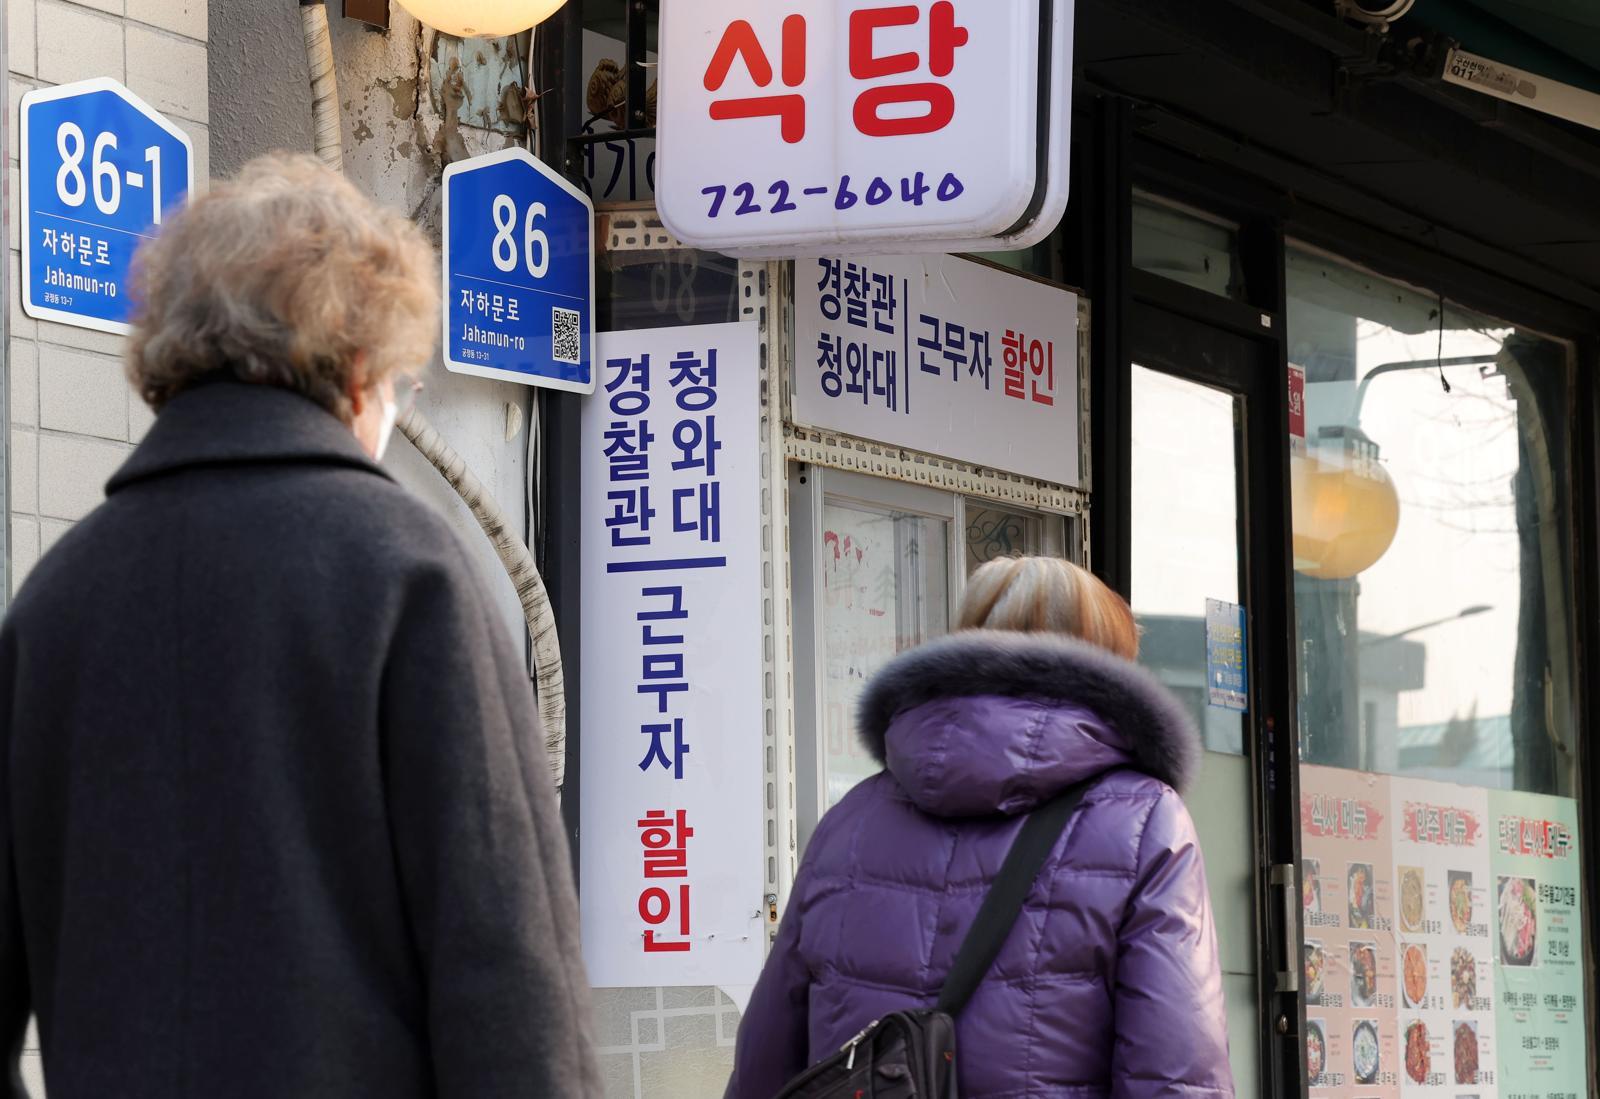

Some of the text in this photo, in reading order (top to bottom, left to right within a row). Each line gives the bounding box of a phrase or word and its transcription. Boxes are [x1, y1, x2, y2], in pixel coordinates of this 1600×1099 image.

[703, 1, 969, 144] 식당
[55, 121, 162, 225] 86-1
[701, 172, 965, 218] 722-6040
[43, 228, 111, 266] 자하문로
[491, 193, 550, 279] 86
[44, 265, 116, 298] Jahamun-ro
[44, 292, 73, 307] 궁정동 13-7
[461, 289, 520, 323] 자하문로
[817, 256, 897, 336] 경찰관
[462, 323, 525, 351] Jahamun-ro
[816, 332, 897, 413] 청와대
[917, 313, 1054, 407] 근무자 할인
[603, 353, 656, 547] 경찰관
[668, 348, 722, 543] 청와대
[636, 585, 693, 953] 근무자 할인
[1312, 793, 1367, 838] 식사 메뉴
[1416, 806, 1467, 846] 안주 메뉴
